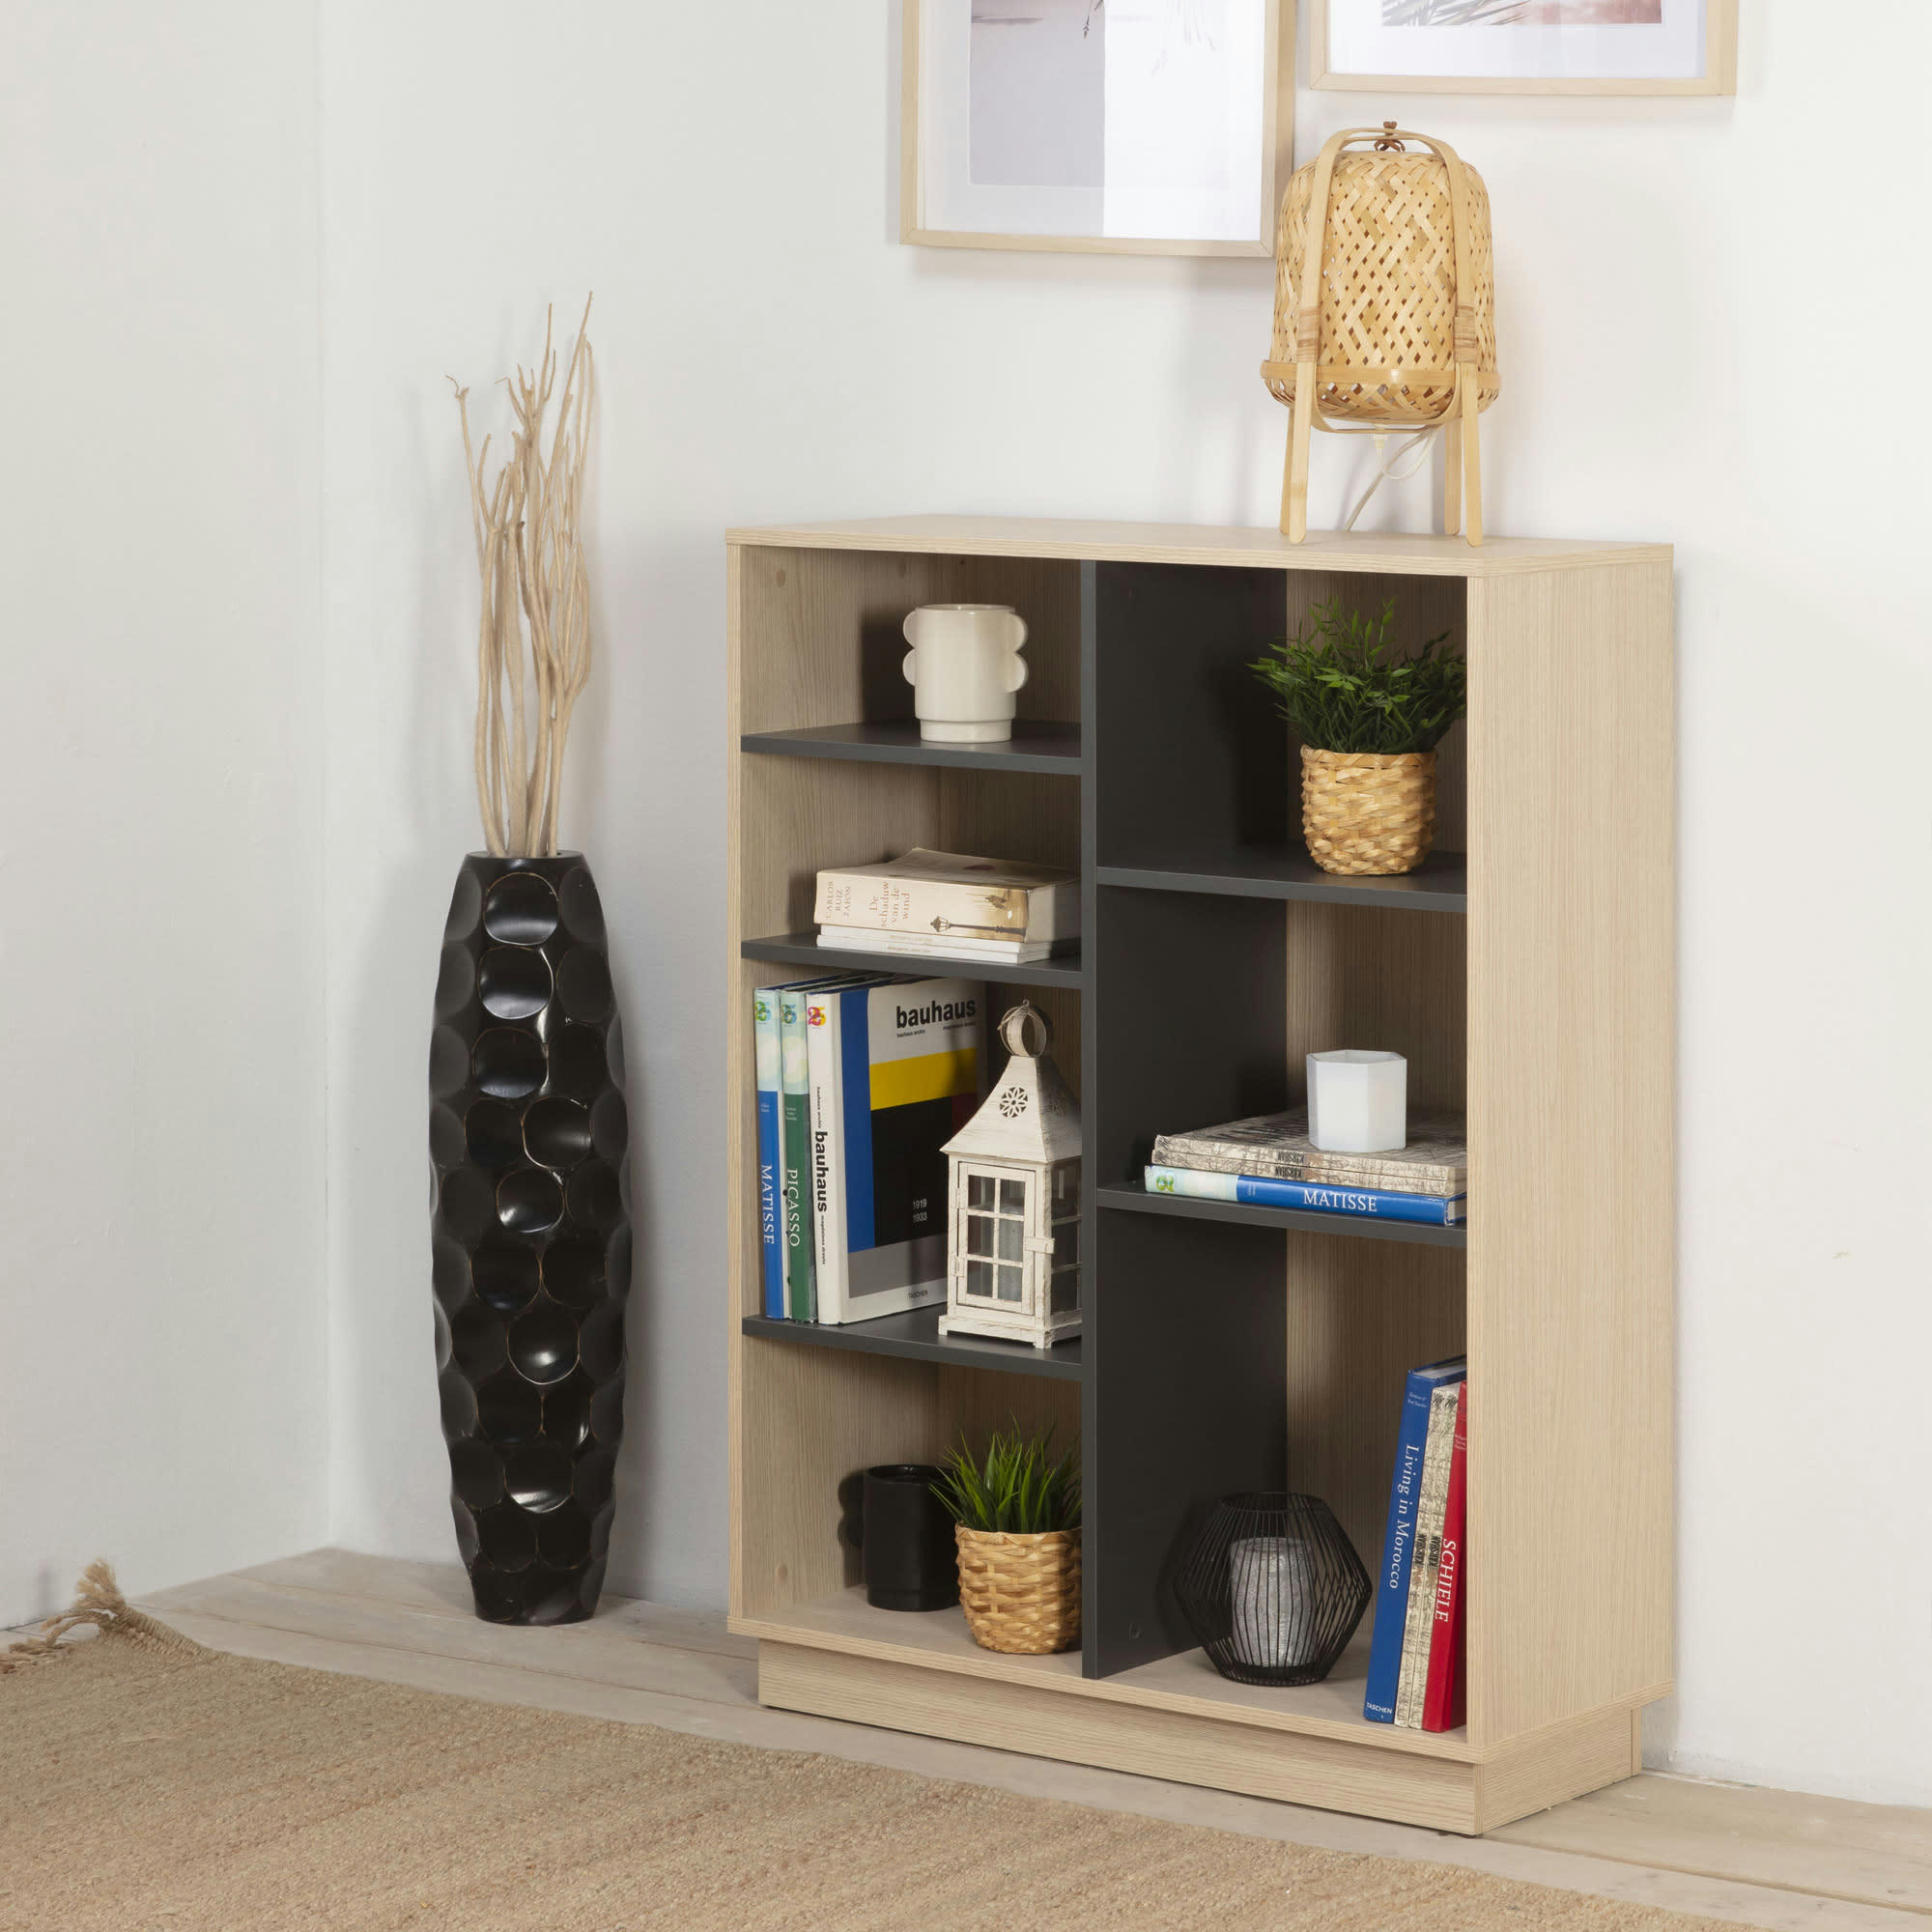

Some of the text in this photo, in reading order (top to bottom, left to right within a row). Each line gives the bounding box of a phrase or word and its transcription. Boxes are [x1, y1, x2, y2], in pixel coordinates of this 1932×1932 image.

[826, 880, 835, 919] CARLOS
[835, 889, 843, 912] RUIZ
[868, 895, 879, 911] De
[879, 881, 890, 927] schaduw
[891, 888, 900, 923] van de
[900, 893, 910, 920] wind
[895, 1000, 976, 1029] bauhaus
[814, 1130, 829, 1212] bauhaus
[761, 1164, 775, 1245] MATISSE
[786, 1168, 801, 1247] PICASSO
[1304, 1189, 1378, 1212] MATISSE
[1389, 1444, 1420, 1589] Living in Morocco
[1435, 1538, 1457, 1623] SCHIELE
[1366, 1701, 1393, 1714] TASCHEN
